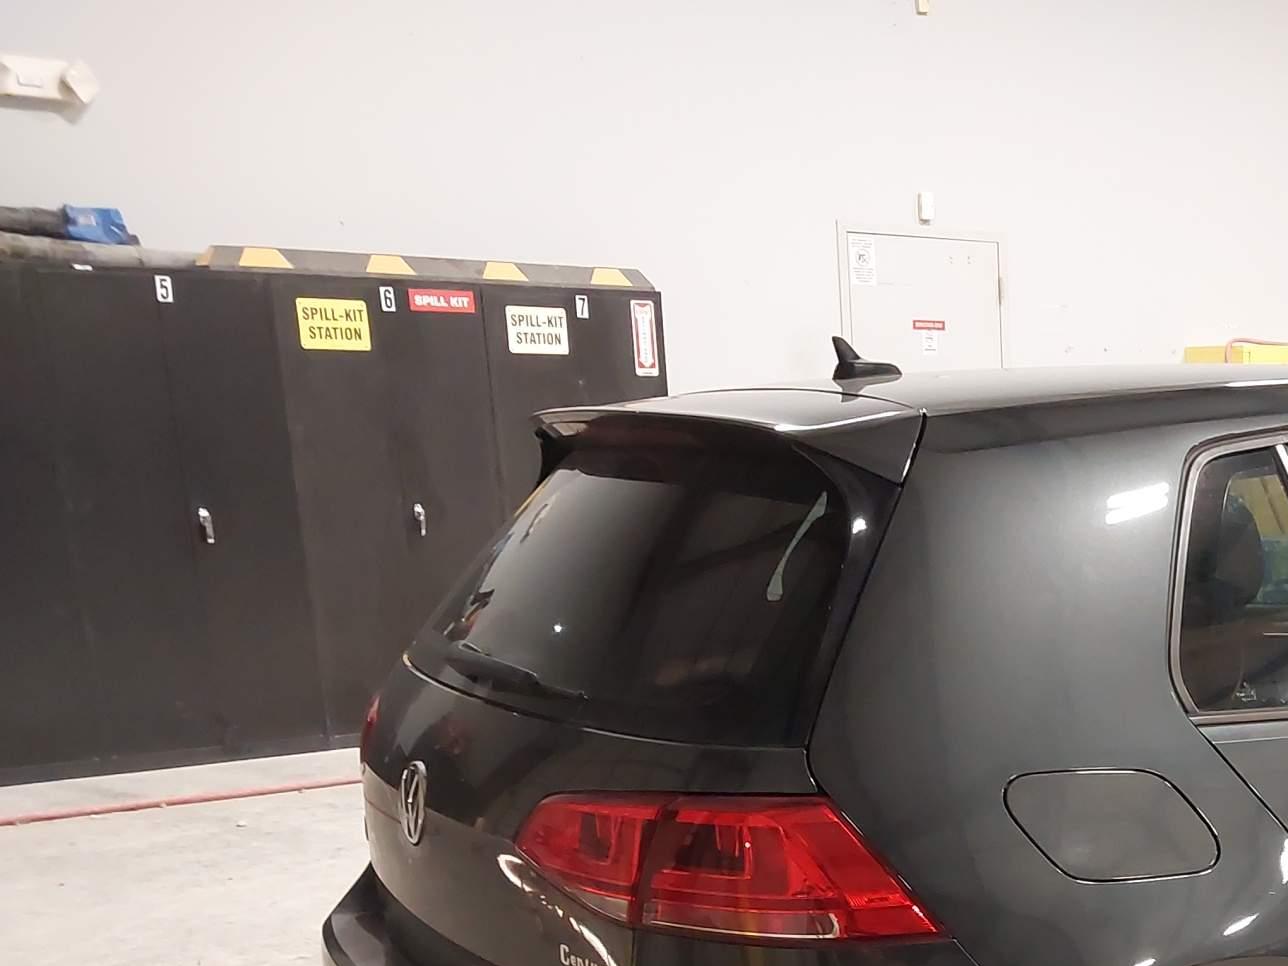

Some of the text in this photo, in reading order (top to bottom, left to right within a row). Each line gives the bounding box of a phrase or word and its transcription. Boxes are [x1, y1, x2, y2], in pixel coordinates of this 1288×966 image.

[159, 278, 169, 299] 5
[384, 289, 393, 309] 6
[414, 295, 471, 308] SPILL KIT
[577, 297, 586, 316] 7
[302, 307, 364, 322] SPILL-KIT
[510, 314, 564, 328] SPILL-KIT
[309, 326, 363, 341] STATION
[516, 331, 562, 345] STATION
